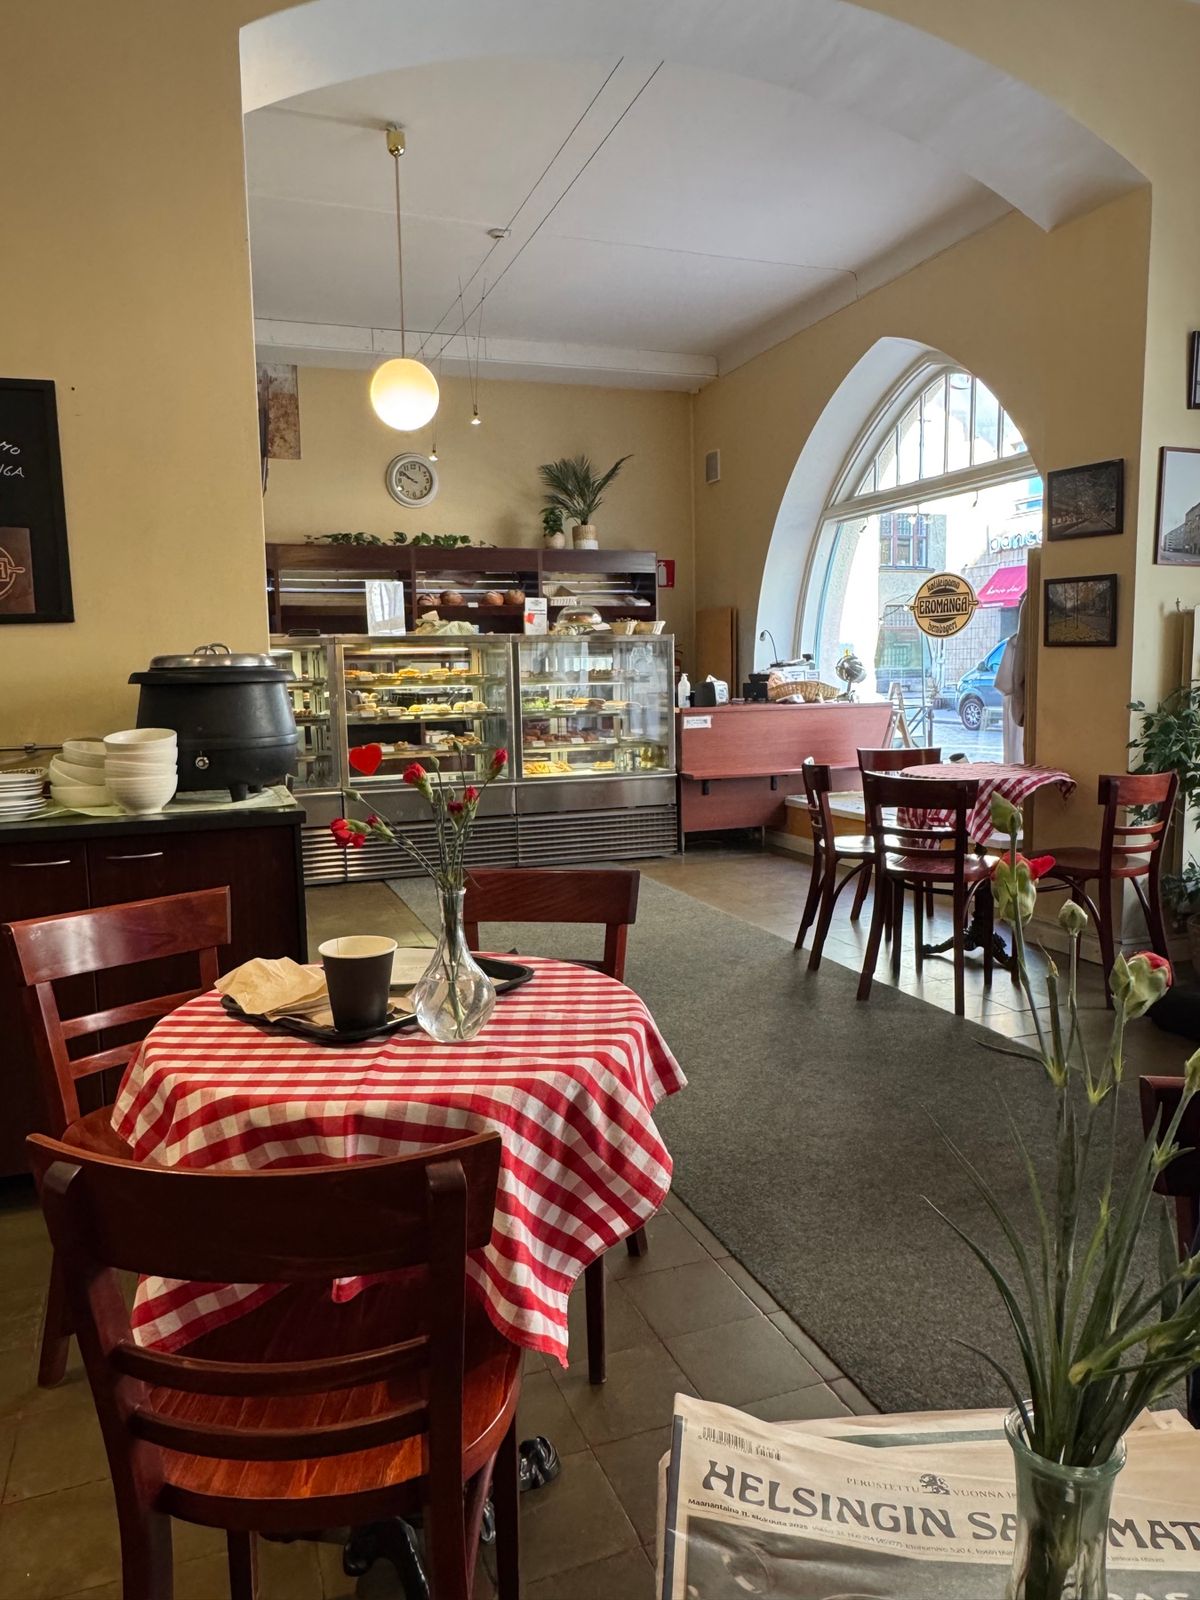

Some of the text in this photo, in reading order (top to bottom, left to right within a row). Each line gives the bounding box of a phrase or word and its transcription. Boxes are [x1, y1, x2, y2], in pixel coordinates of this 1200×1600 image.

[919, 596, 968, 615] EROMANGA
[702, 1459, 956, 1538] HELSINGIN
[846, 1477, 920, 1493] PERUSTETTU
[953, 1489, 1006, 1498] VUONNA
[688, 1498, 740, 1515] Maanantaina
[789, 1522, 809, 1530] 2025
